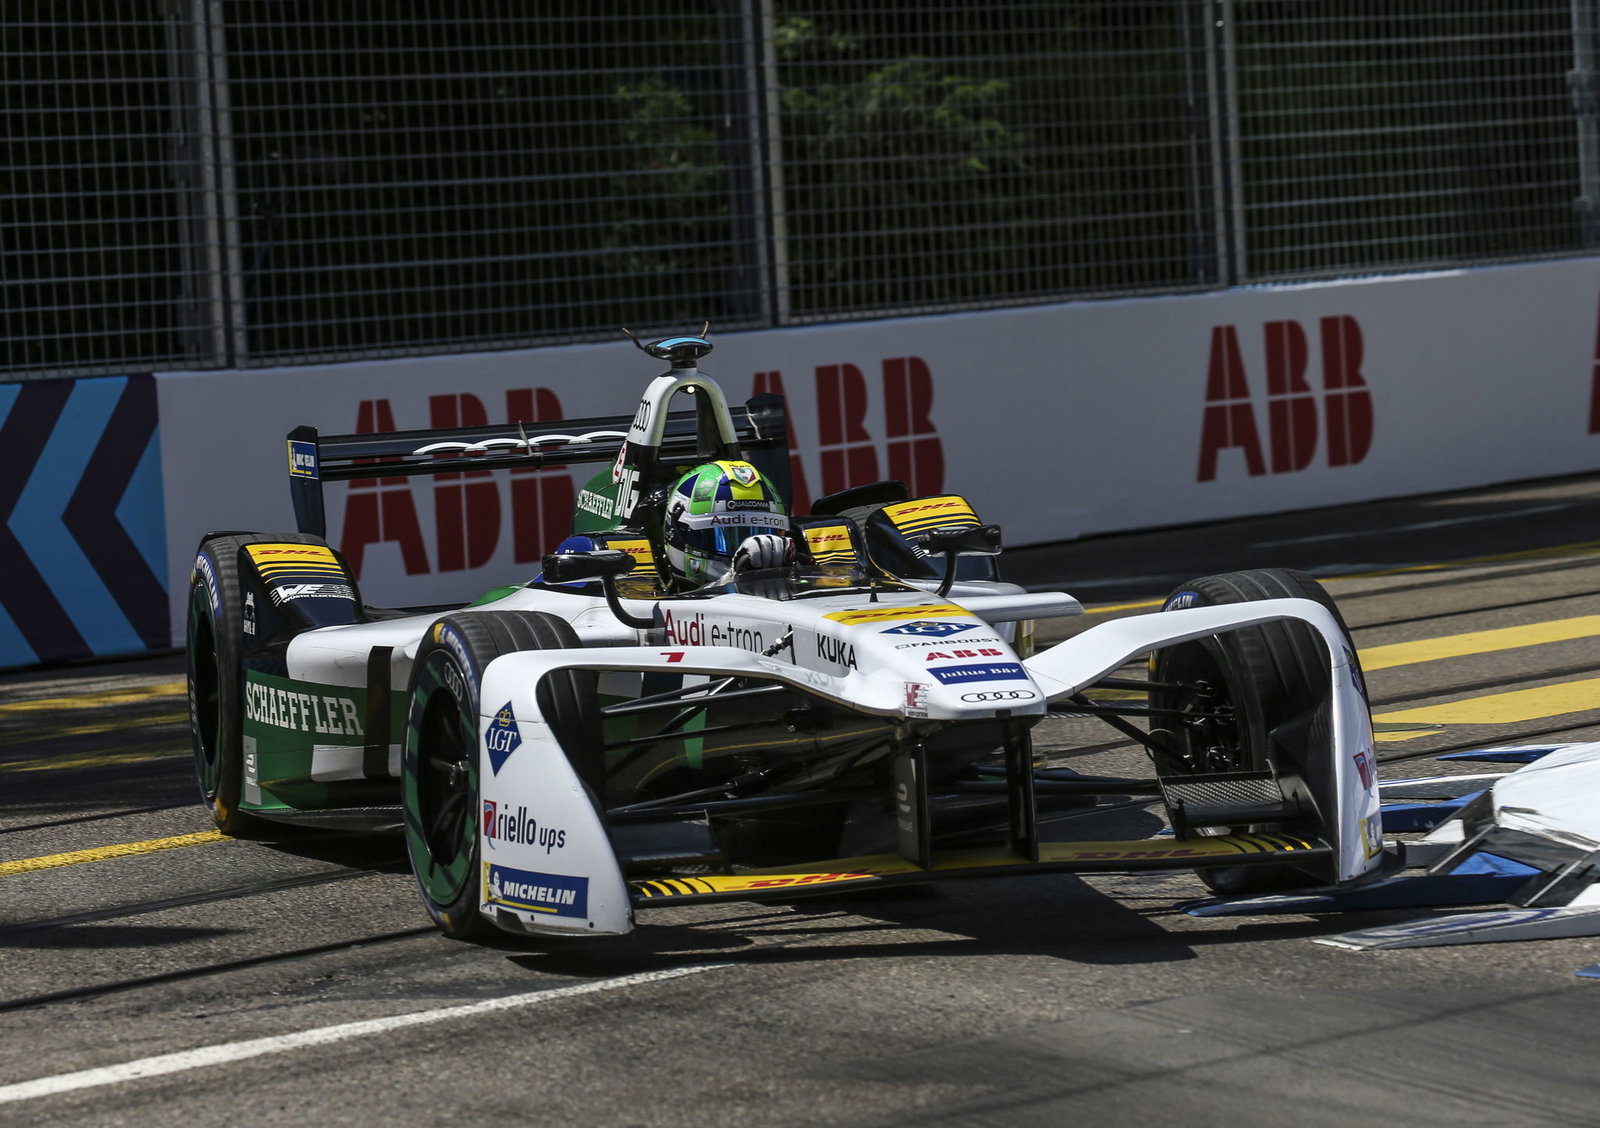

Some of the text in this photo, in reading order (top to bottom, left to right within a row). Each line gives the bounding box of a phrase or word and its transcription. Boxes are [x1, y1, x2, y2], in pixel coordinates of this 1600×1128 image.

[1196, 314, 1375, 484] ABB
[339, 386, 577, 583] ABB
[576, 489, 614, 521] SCHAEFFLER
[896, 502, 962, 515] DHL
[710, 514, 785, 527] Audi e-tron
[811, 533, 847, 544] DHL
[275, 583, 325, 600] WE
[846, 608, 951, 620] DHL
[663, 609, 764, 652] Audi e-tron
[897, 622, 966, 635] LGT
[816, 632, 858, 671] KUKA
[911, 637, 1001, 648] FANBOOST
[925, 648, 1004, 661] ABB
[940, 666, 1019, 680] Julius Bär
[245, 681, 365, 736] SCHAEFFLER
[487, 727, 518, 753] LGT
[497, 803, 566, 854] riello ups
[1074, 848, 1208, 860] DHL
[748, 868, 882, 888] DHL
[503, 880, 577, 905] MICHELIN
